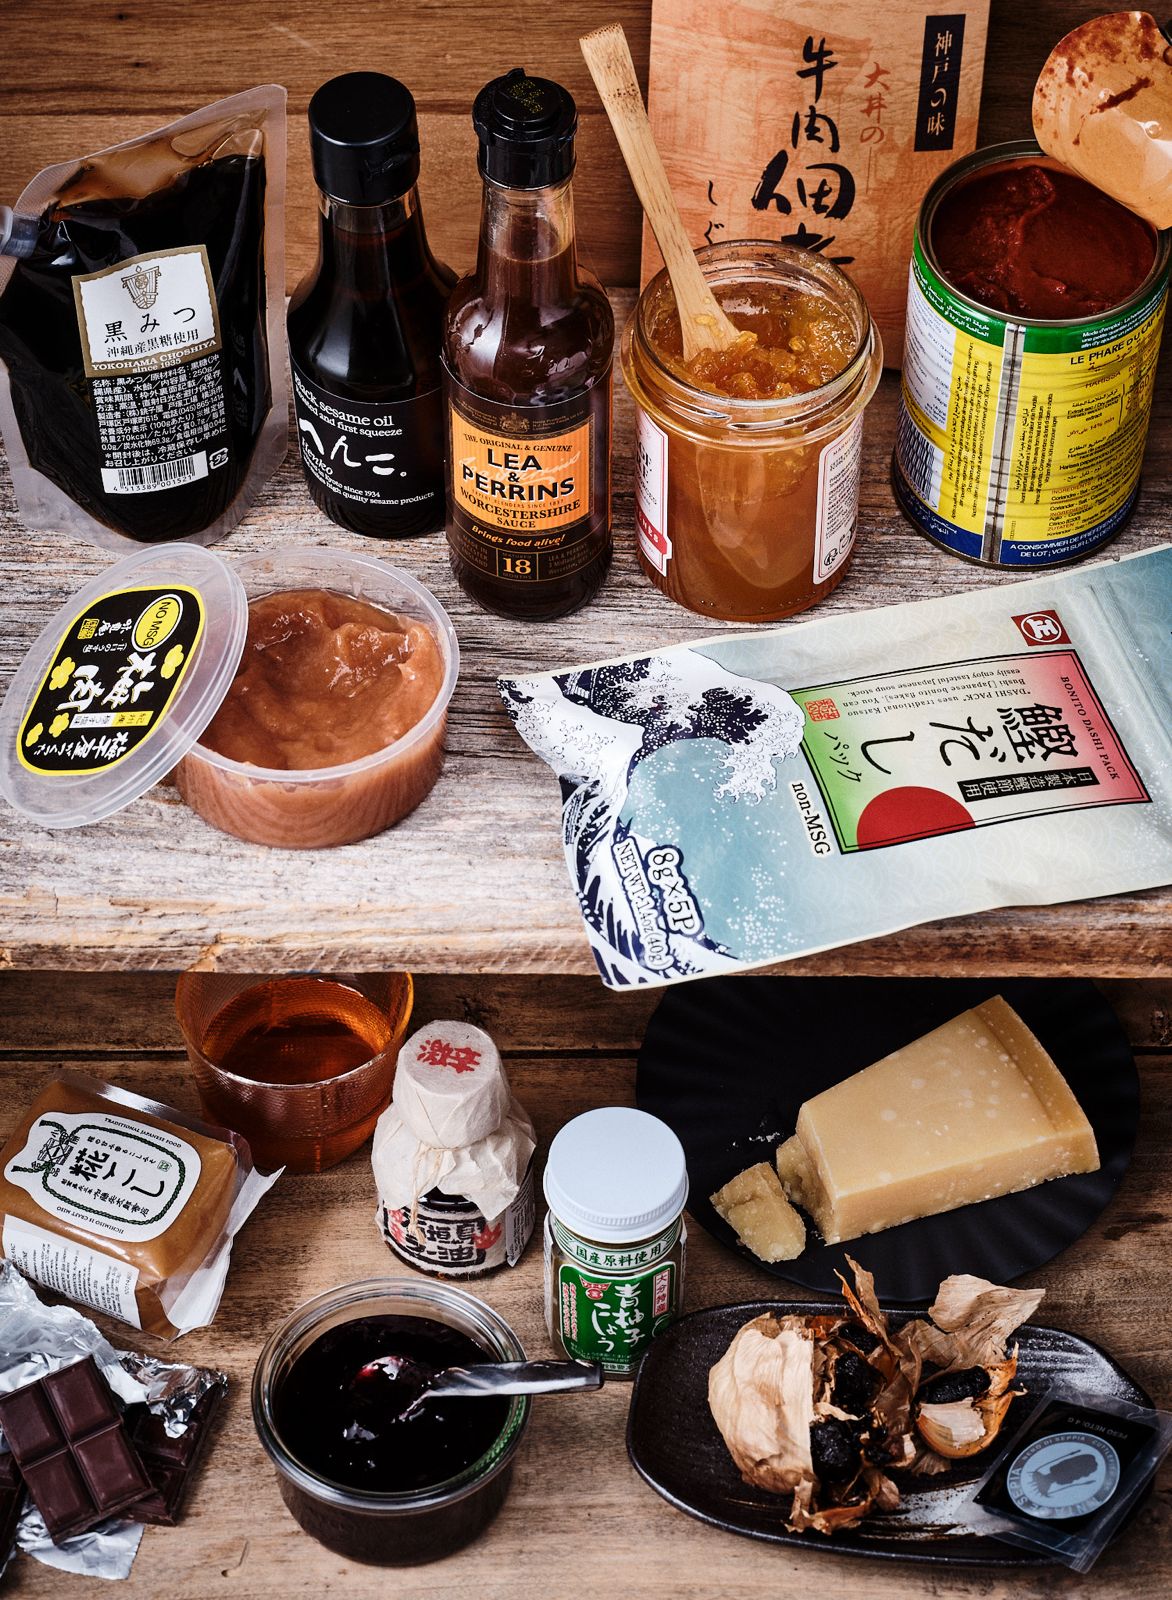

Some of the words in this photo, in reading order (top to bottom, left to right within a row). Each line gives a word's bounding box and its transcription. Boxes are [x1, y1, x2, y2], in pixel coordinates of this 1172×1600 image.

[927, 30, 952, 136] 神戸の味
[860, 62, 890, 145] 大井の
[104, 307, 195, 343] 黒みつ
[106, 329, 199, 358] 沖縄産黒糖使用
[1071, 356, 1084, 365] LE
[1089, 342, 1124, 361] PHARE
[1127, 334, 1140, 345] DU
[92, 358, 156, 371] YOKOHAMA
[160, 340, 217, 362] CHOSHIYA
[132, 364, 159, 373] since
[160, 359, 181, 368] 1935
[319, 411, 336, 426] and
[337, 421, 358, 434] first
[360, 428, 402, 437] squeeze
[320, 401, 370, 426] sesame
[373, 416, 394, 426] oil
[464, 433, 478, 444] THE
[480, 437, 523, 451] ORIGINAL
[488, 448, 542, 471] LEA
[462, 464, 575, 502] PERRINS
[508, 472, 520, 483] &
[343, 490, 368, 503] quality
[400, 491, 434, 505] products
[344, 486, 363, 495] since
[460, 487, 580, 520] WORCESTERSHIRE
[497, 517, 536, 528] SAUCE
[471, 525, 503, 543] Brings
[506, 538, 531, 547] food
[534, 534, 565, 547] alive!
[1017, 538, 1069, 550] CONSOMMER
[1051, 546, 1069, 555] VOIR
[503, 557, 532, 574] 18
[154, 601, 171, 619] NO
[143, 619, 162, 647] MSG
[1027, 618, 1058, 641] 正
[937, 672, 970, 684] tasteful
[971, 668, 994, 680] enjoy
[995, 665, 1020, 677] easily
[998, 676, 1025, 688] Bushi
[846, 687, 873, 698] stock.
[874, 683, 895, 692] soup
[896, 677, 935, 691] Japanese
[917, 685, 948, 698] bonito
[949, 678, 997, 695] [Japanese
[841, 699, 859, 707] can
[861, 696, 879, 705] You
[883, 697, 934, 713] traditional
[936, 694, 959, 704] uses
[846, 706, 881, 718] Katsuo
[861, 703, 1079, 775] 鰹だし
[1060, 676, 1087, 718] BONITO
[1081, 719, 1105, 752] DASHI
[1099, 754, 1121, 781] PACK
[824, 731, 863, 783] パック
[962, 768, 1096, 801] 日本製造鰹節使用
[792, 781, 831, 856] non-MSG
[618, 842, 638, 872] NET
[416, 1039, 481, 1074] 激辛
[105, 1117, 139, 1134] TRADITIONAL
[140, 1131, 165, 1143] JAPANESE
[166, 1138, 182, 1148] FOOD
[69, 1147, 165, 1197] 糀こし
[56, 1206, 71, 1214] MISO
[72, 1211, 88, 1221] CRAFT
[407, 1220, 475, 1244] 垣島
[575, 1244, 662, 1266] 国産原料使用
[612, 1283, 645, 1347] 青柚子
[592, 1302, 617, 1352] こしょう
[1106, 1429, 1128, 1440] PESO
[1009, 1467, 1027, 1506] SEPIA
